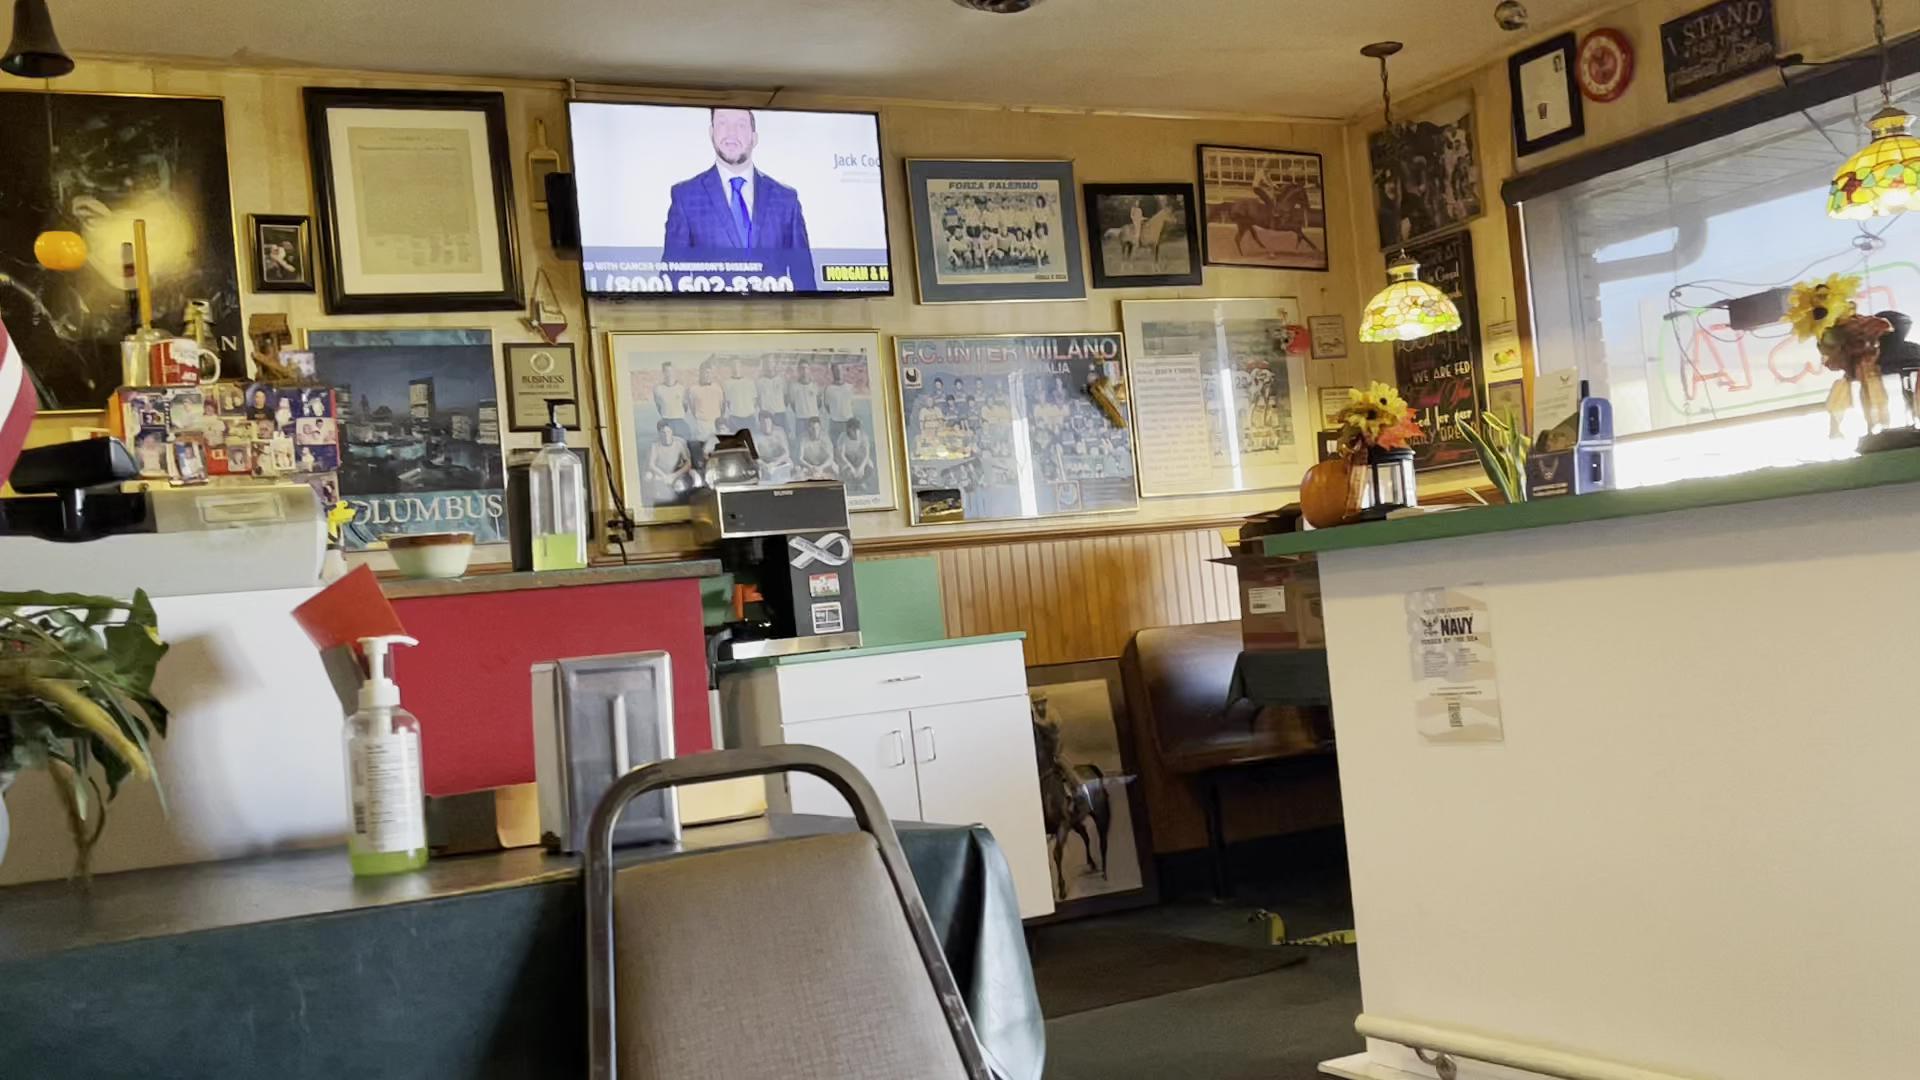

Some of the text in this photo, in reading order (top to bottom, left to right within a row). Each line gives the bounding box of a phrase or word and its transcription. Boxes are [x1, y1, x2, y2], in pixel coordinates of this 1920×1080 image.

[1682, 1, 1762, 38] STAND
[833, 153, 857, 169] Jack
[948, 182, 1039, 190] FORZA PALERMO
[826, 266, 868, 281] MORGAN
[946, 342, 1018, 364] INTER
[1024, 337, 1117, 362] MILANO
[522, 375, 565, 384] BUSINESS
[343, 494, 503, 525] OLUMBUS
[1440, 617, 1473, 636] NAVY
